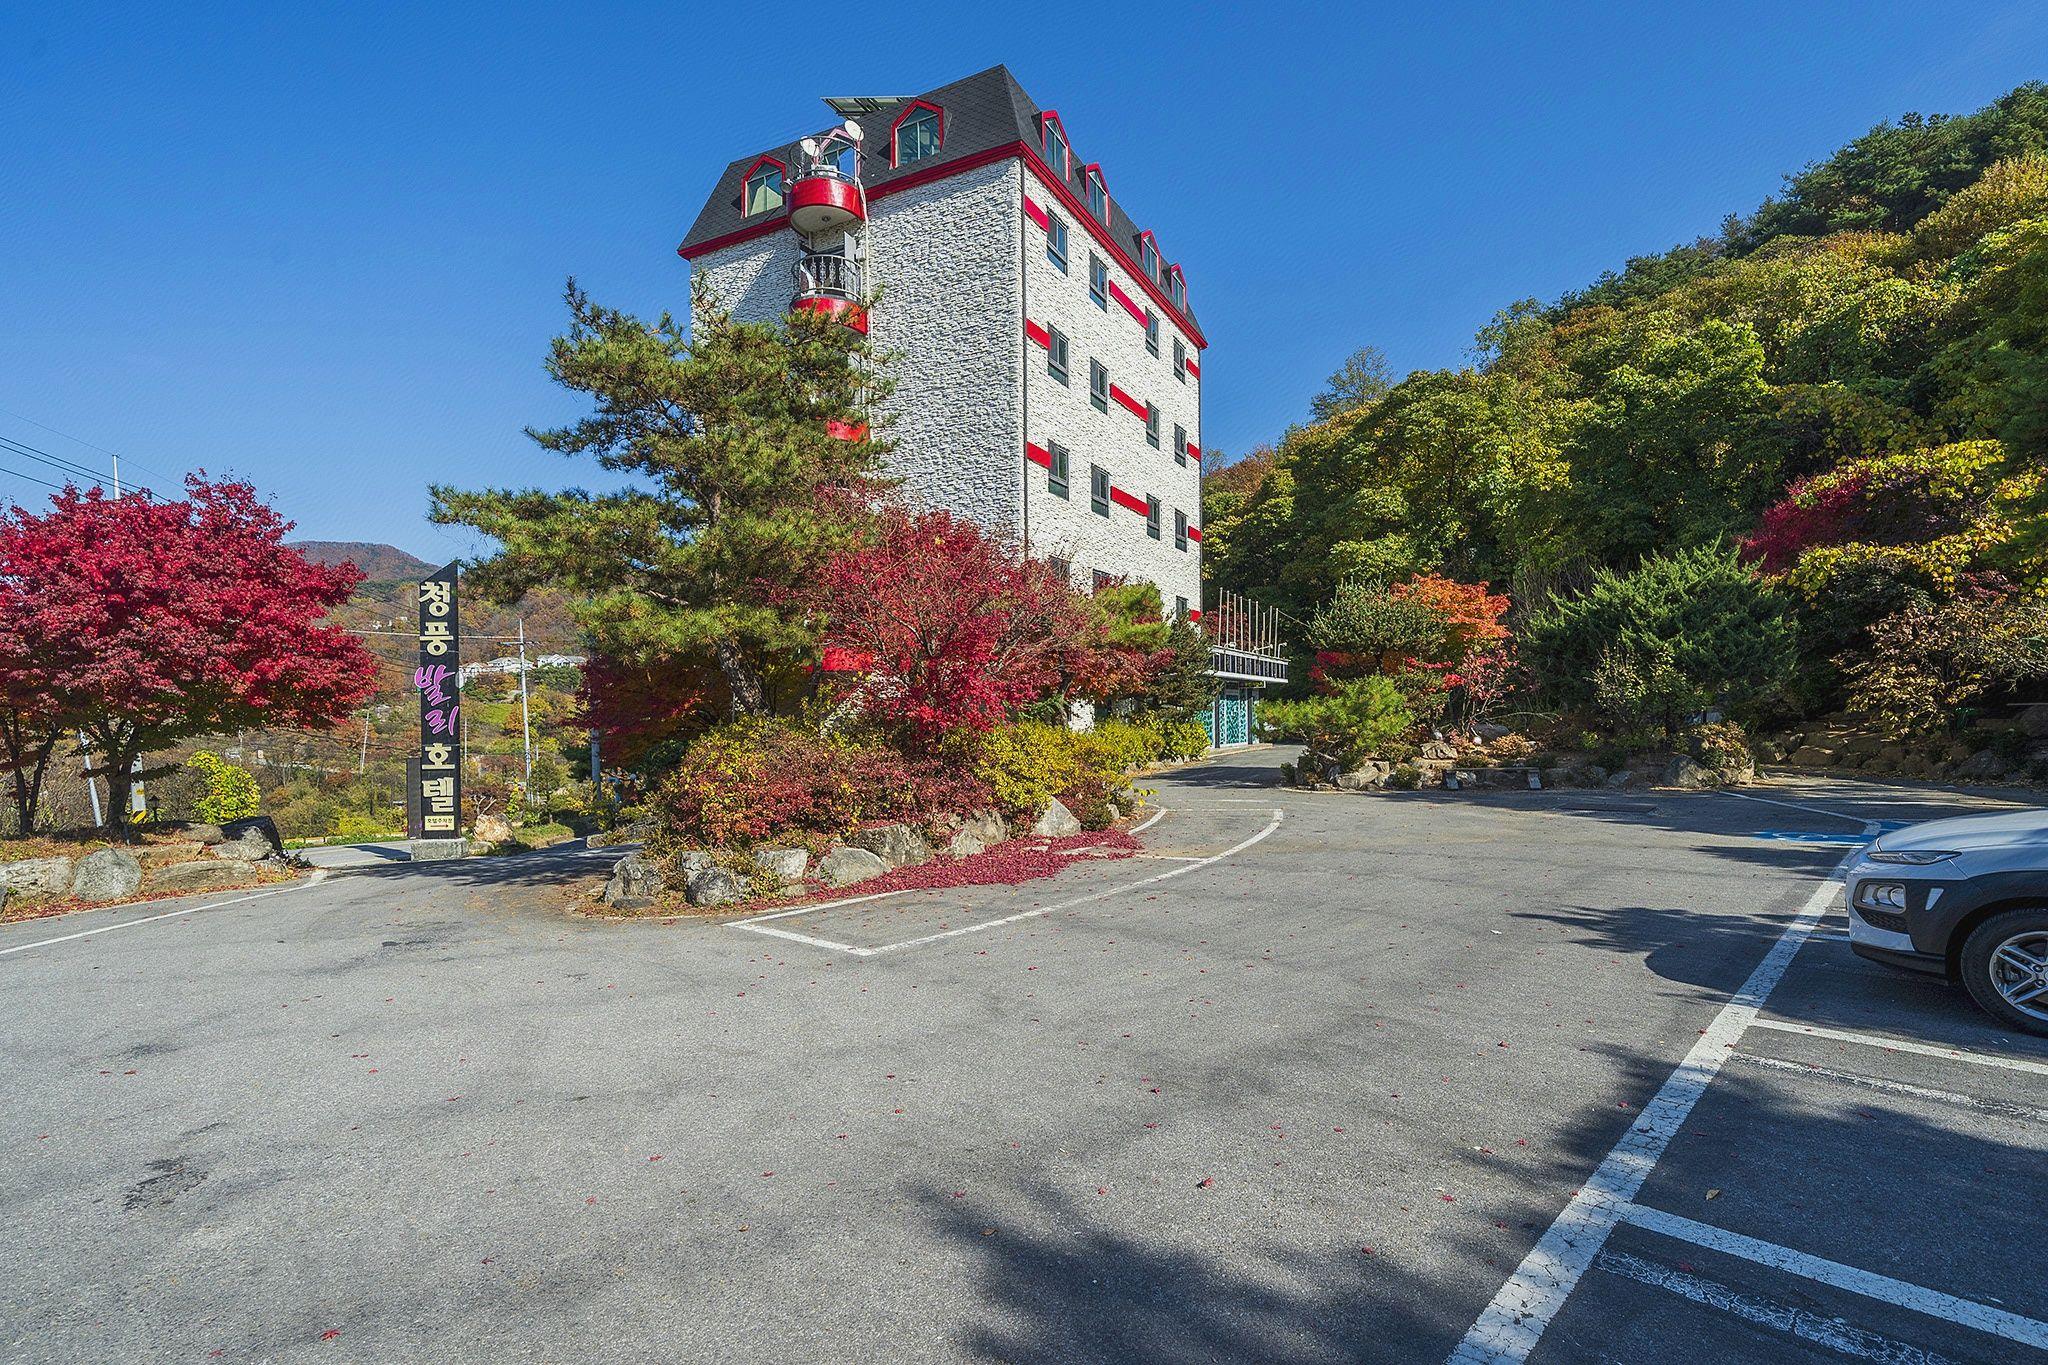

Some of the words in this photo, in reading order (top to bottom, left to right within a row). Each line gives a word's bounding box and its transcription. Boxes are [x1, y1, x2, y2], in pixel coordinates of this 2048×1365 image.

[418, 581, 454, 656] 청풍
[414, 664, 459, 736] 발리
[421, 742, 456, 813] 호텔
